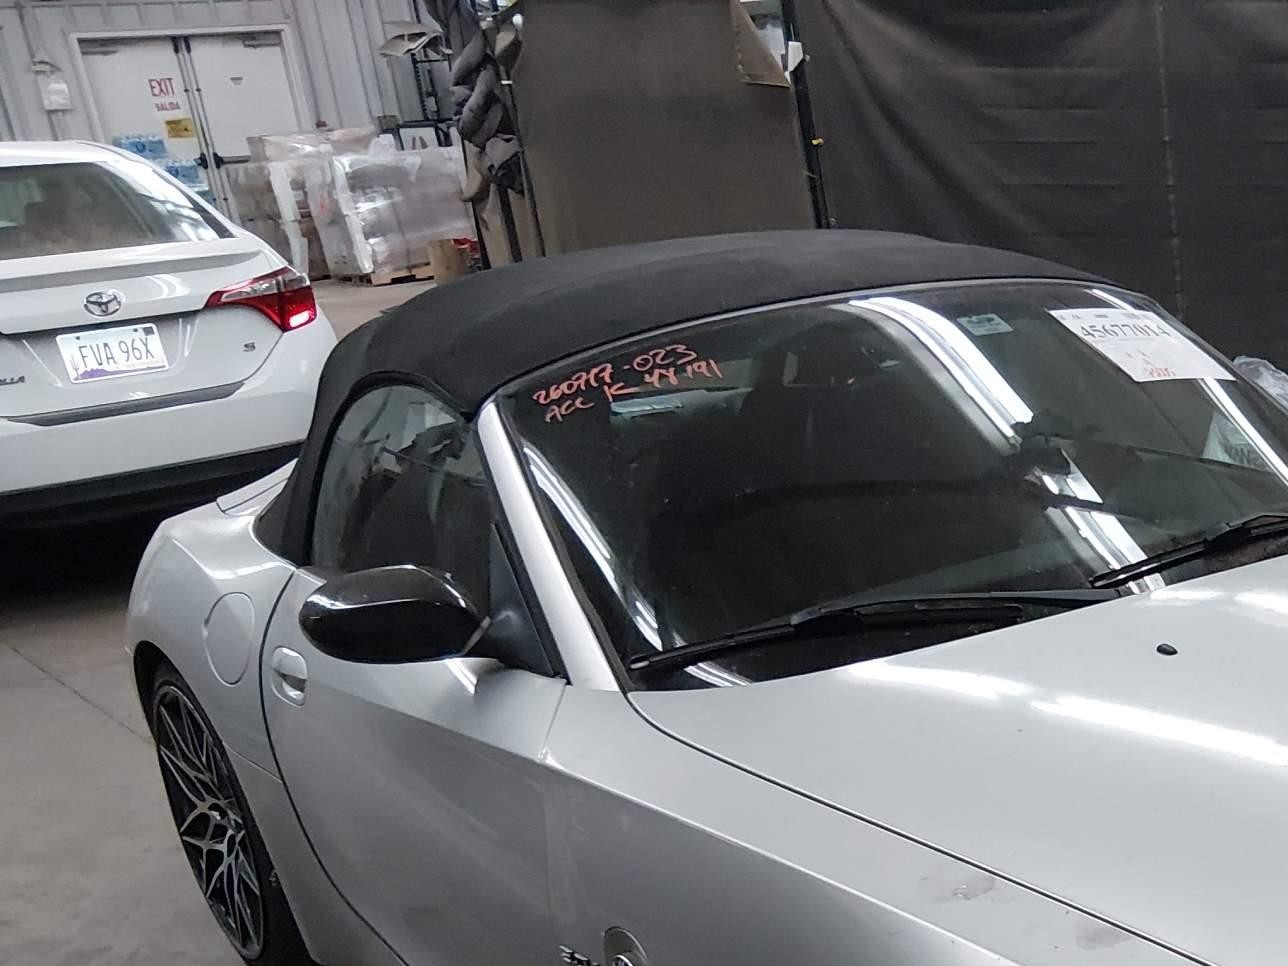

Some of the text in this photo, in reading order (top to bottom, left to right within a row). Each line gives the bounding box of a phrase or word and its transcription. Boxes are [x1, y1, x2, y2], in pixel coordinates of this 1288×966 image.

[148, 77, 175, 97] EXIT
[1080, 323, 1173, 340] 45677014
[79, 336, 155, 370] FVA 96X
